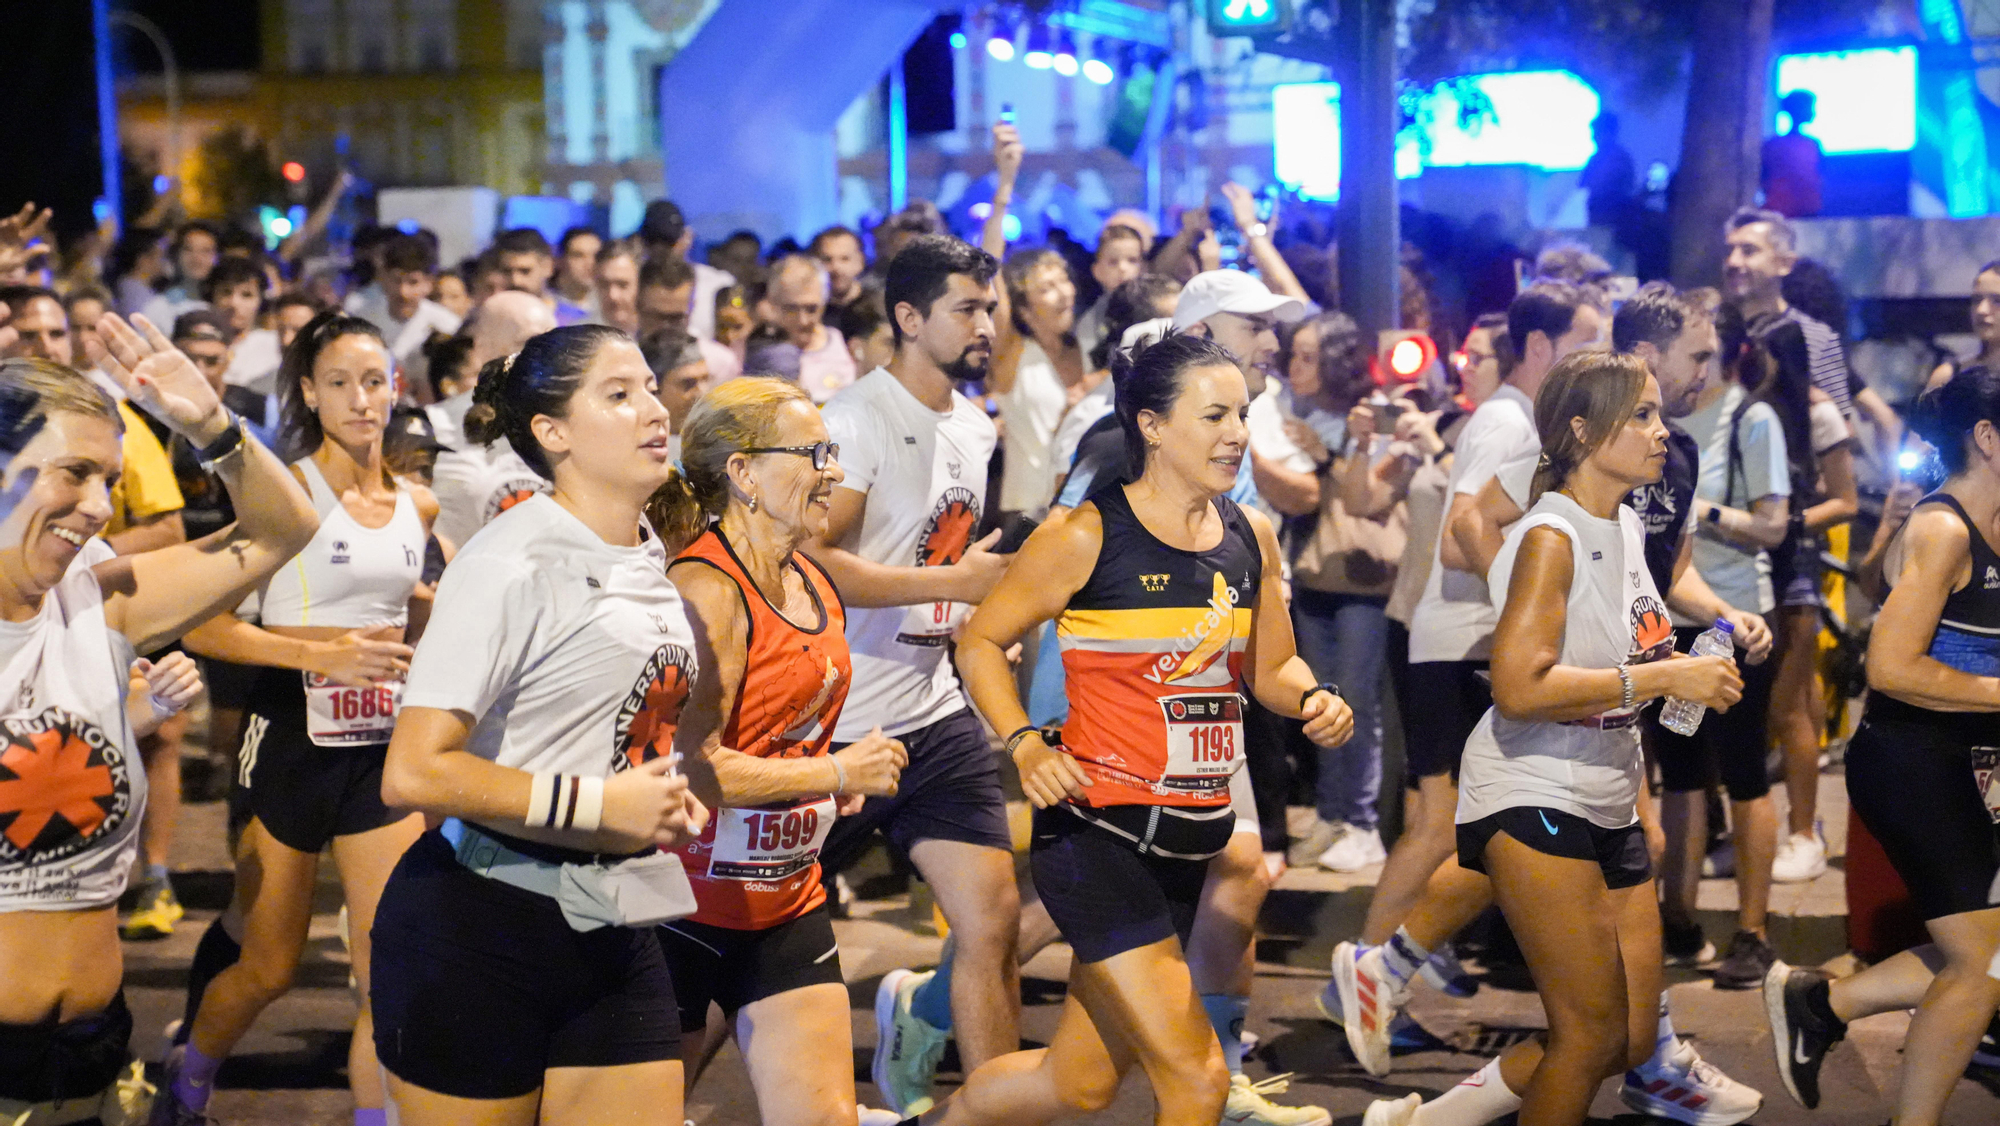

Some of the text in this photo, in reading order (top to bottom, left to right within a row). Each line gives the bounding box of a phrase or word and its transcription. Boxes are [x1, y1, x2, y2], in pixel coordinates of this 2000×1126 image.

[945, 486, 971, 504] RUN
[1633, 597, 1657, 618] RUN
[1143, 586, 1239, 684] verticalia
[656, 645, 686, 669] RUN
[328, 687, 393, 720] 1686
[4, 706, 67, 738] RUN
[1189, 725, 1234, 762] 1193
[743, 808, 818, 851] 1599
[744, 881, 779, 892] dobuss
